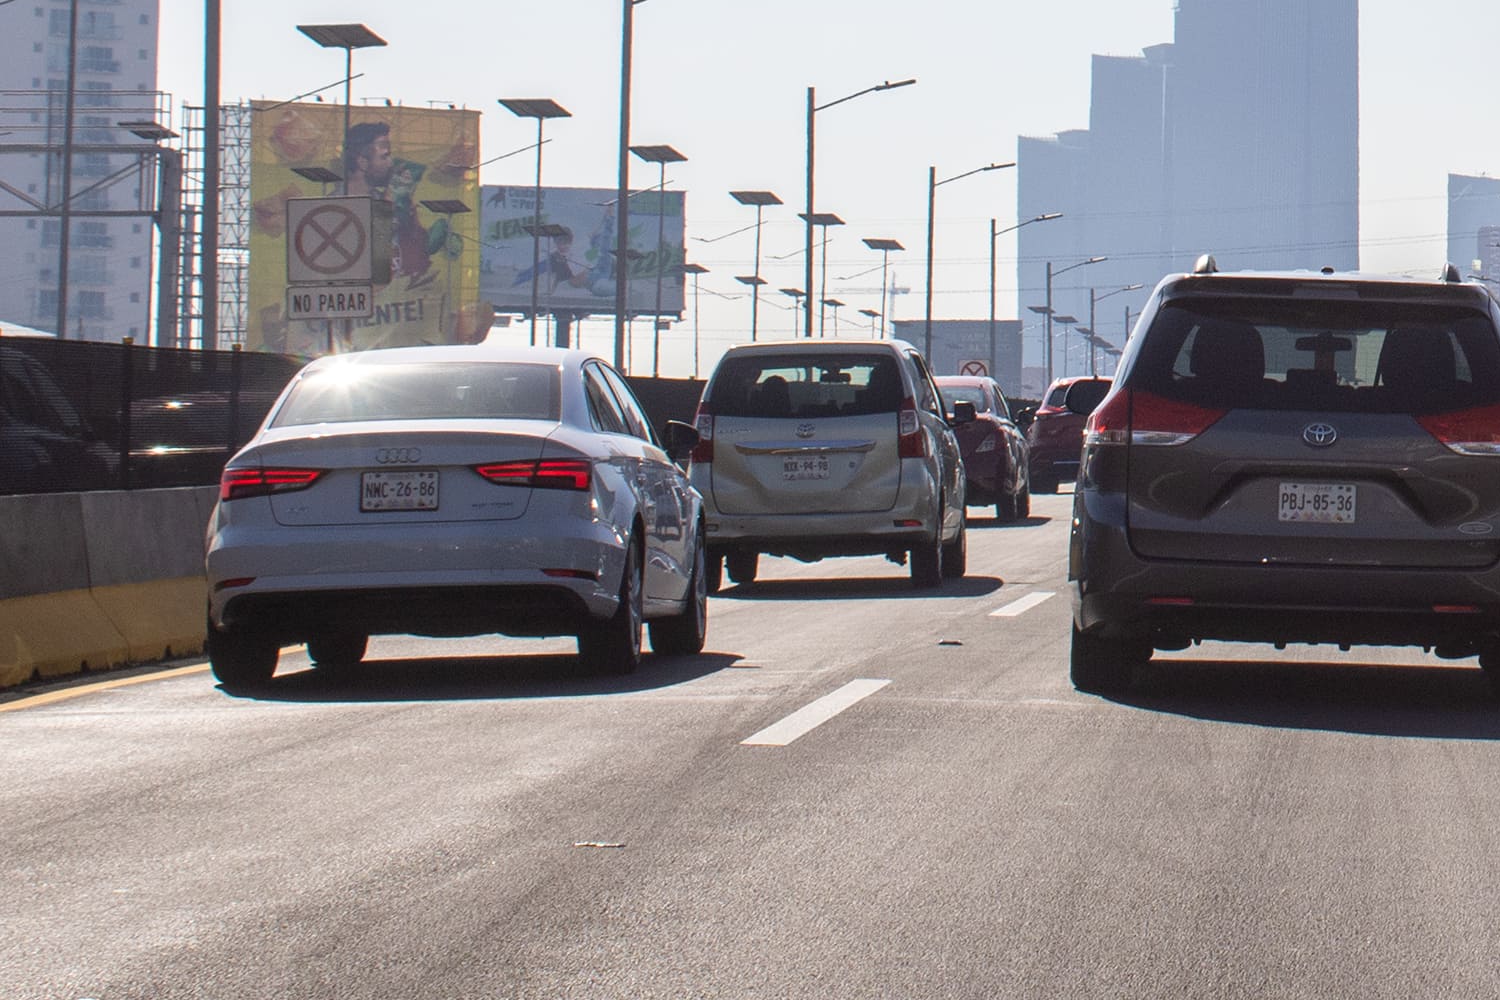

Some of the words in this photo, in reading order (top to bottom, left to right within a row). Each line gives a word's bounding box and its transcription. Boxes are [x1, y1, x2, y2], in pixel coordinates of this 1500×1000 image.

[293, 293, 311, 313] NO
[319, 292, 366, 312] PARAR
[366, 481, 435, 499] NWC-26-86
[1281, 492, 1353, 512] PBJ-85-36
